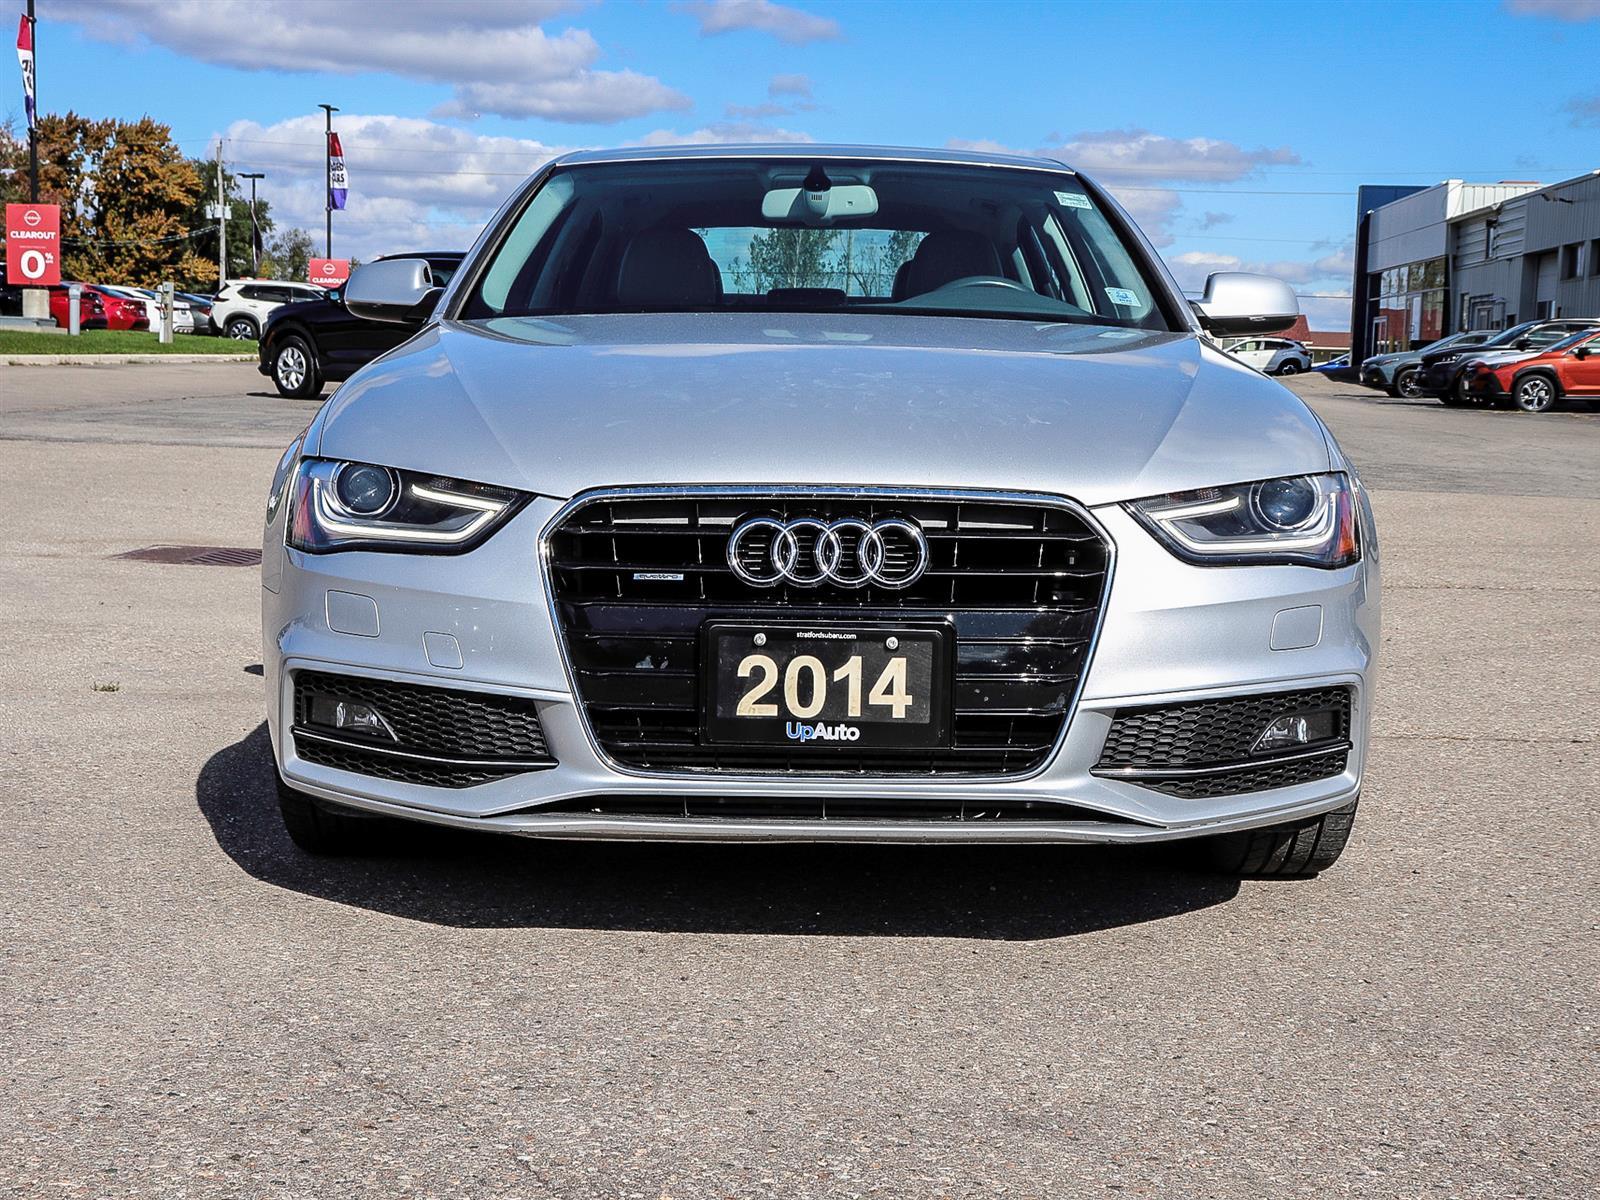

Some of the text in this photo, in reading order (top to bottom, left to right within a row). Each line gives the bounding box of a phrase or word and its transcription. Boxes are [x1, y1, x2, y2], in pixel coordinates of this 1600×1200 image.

[10, 231, 56, 239] CLEAROUT
[796, 631, 857, 639] stratfordsubaru.com
[736, 654, 913, 718] 2014
[786, 721, 860, 743] UpAuto
